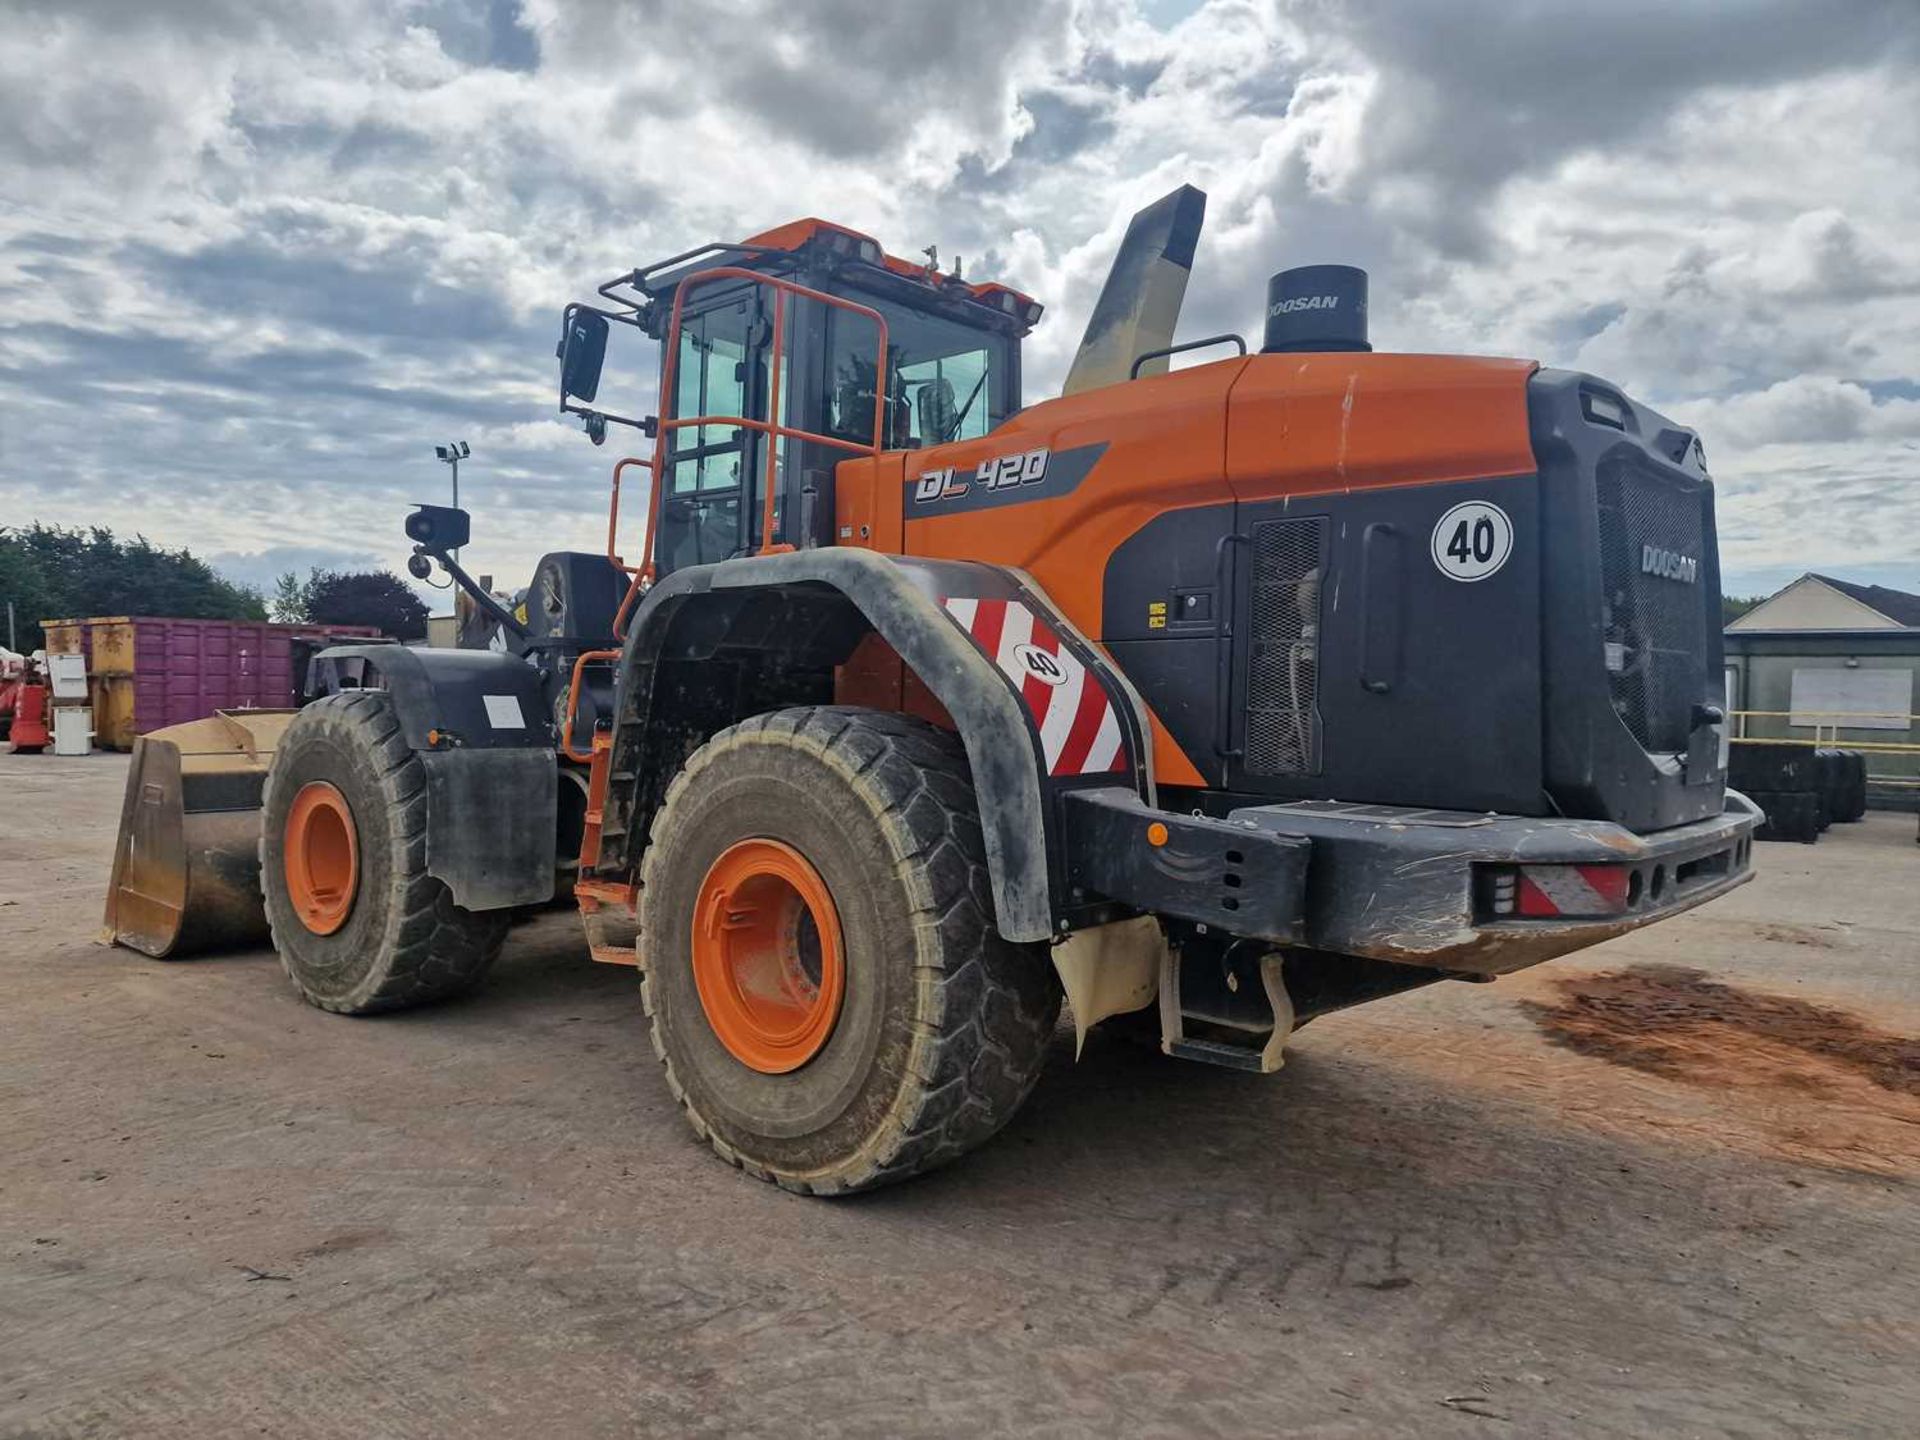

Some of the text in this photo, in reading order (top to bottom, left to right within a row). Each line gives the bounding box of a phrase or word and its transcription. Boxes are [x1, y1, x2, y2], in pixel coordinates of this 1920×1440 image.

[915, 448, 1051, 503] DL 420
[1447, 517, 1494, 563] 40
[1642, 545, 1697, 584] DOOSAN
[1025, 651, 1061, 677] 40
